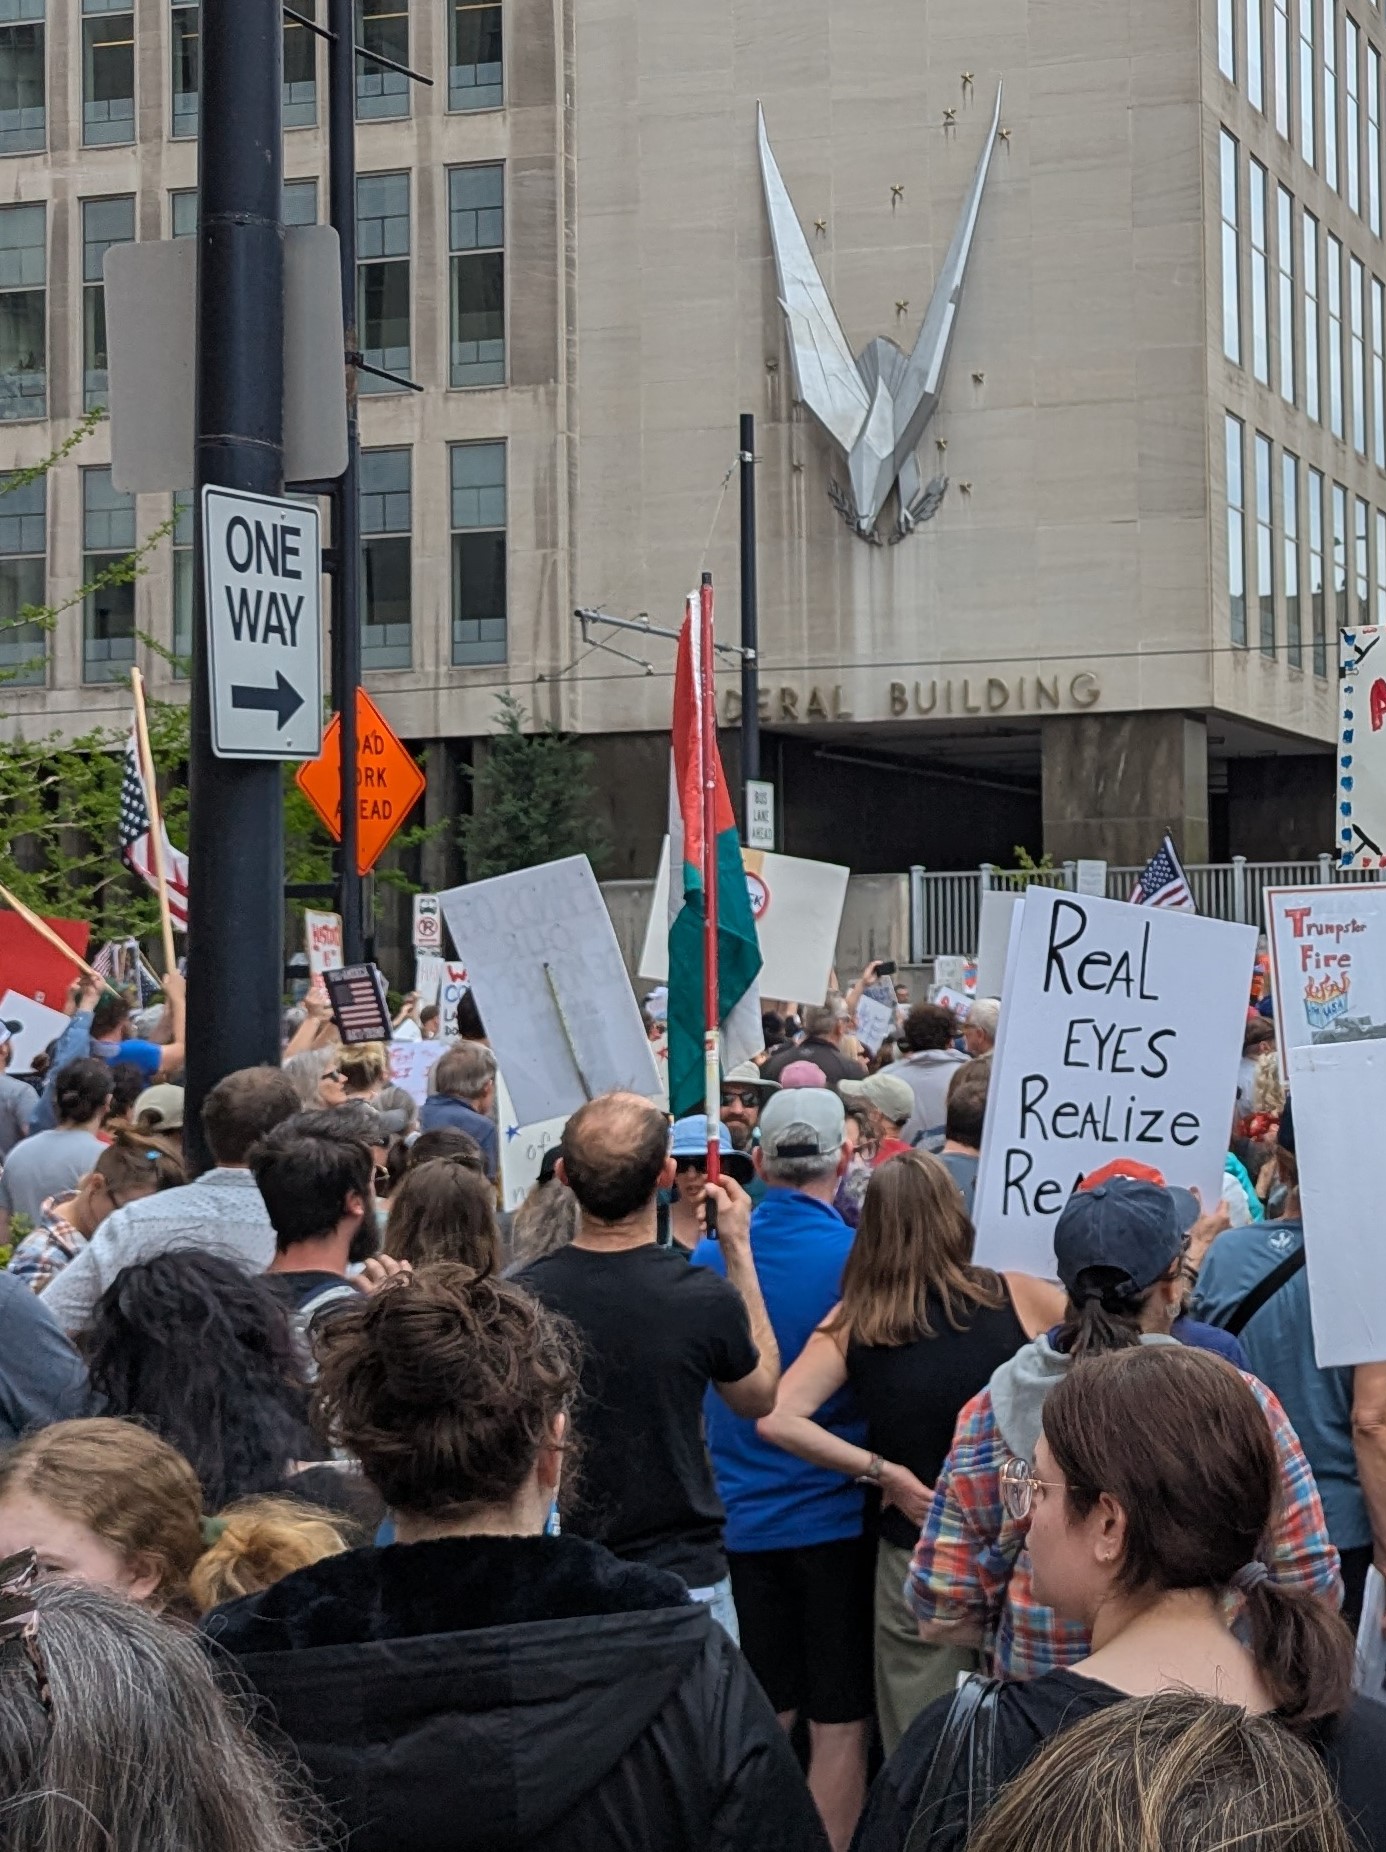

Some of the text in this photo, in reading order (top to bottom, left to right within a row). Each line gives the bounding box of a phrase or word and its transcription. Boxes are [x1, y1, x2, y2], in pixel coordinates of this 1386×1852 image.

[226, 514, 303, 580] ONE
[225, 585, 305, 648] WAY
[725, 671, 1101, 723] DERAL BUILDING
[334, 799, 392, 820] AEAD
[1284, 906, 1368, 944] Trumpster
[1300, 944, 1352, 973] Fire
[1063, 1018, 1177, 1079] EYES
